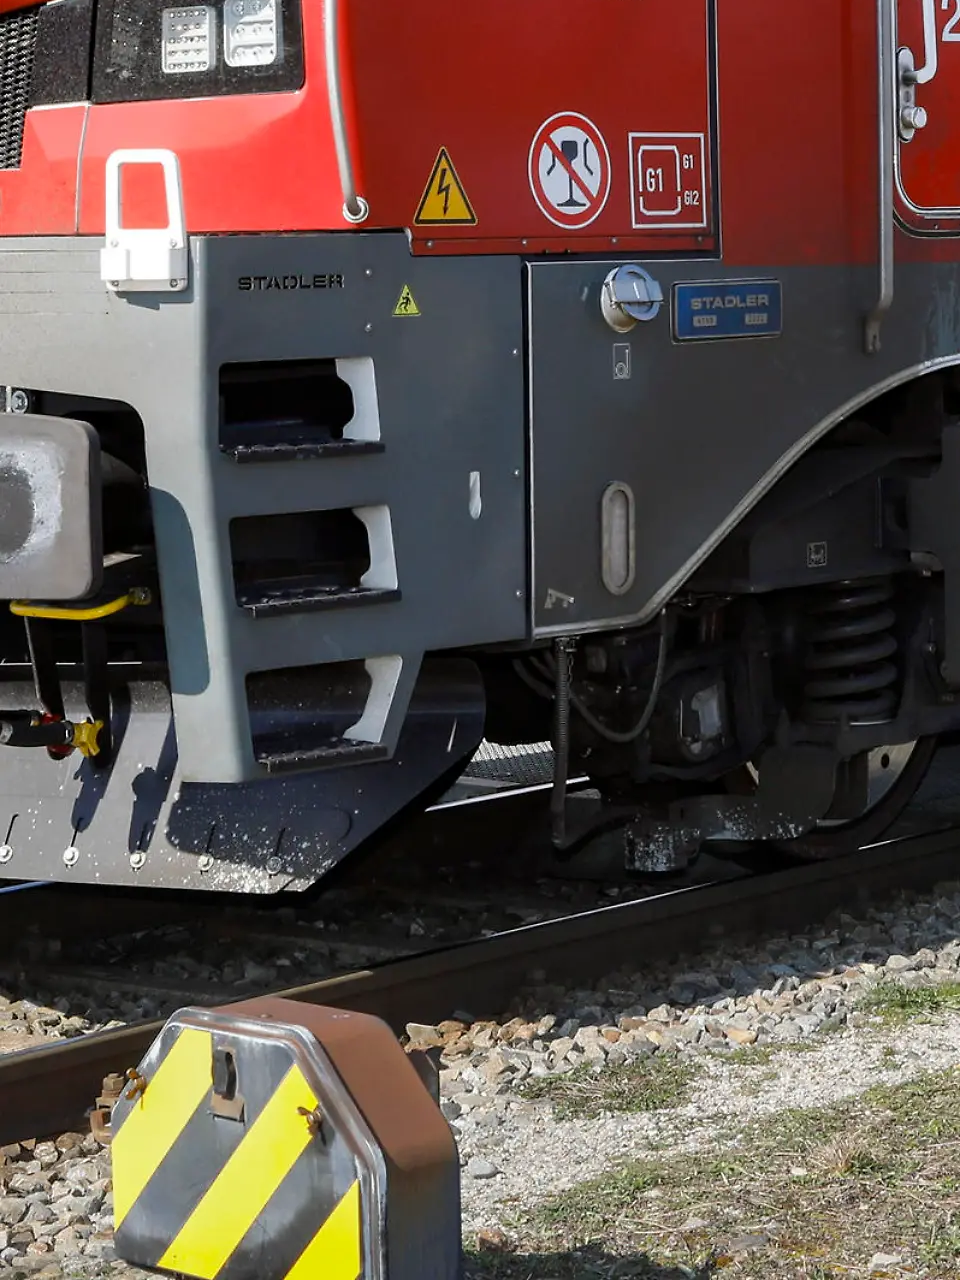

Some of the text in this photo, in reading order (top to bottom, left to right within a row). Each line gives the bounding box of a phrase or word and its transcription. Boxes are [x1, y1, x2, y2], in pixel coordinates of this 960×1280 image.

[682, 154, 694, 169] G1
[645, 168, 663, 192] G1
[238, 272, 345, 290] STADLER
[691, 295, 769, 311] STADLER
